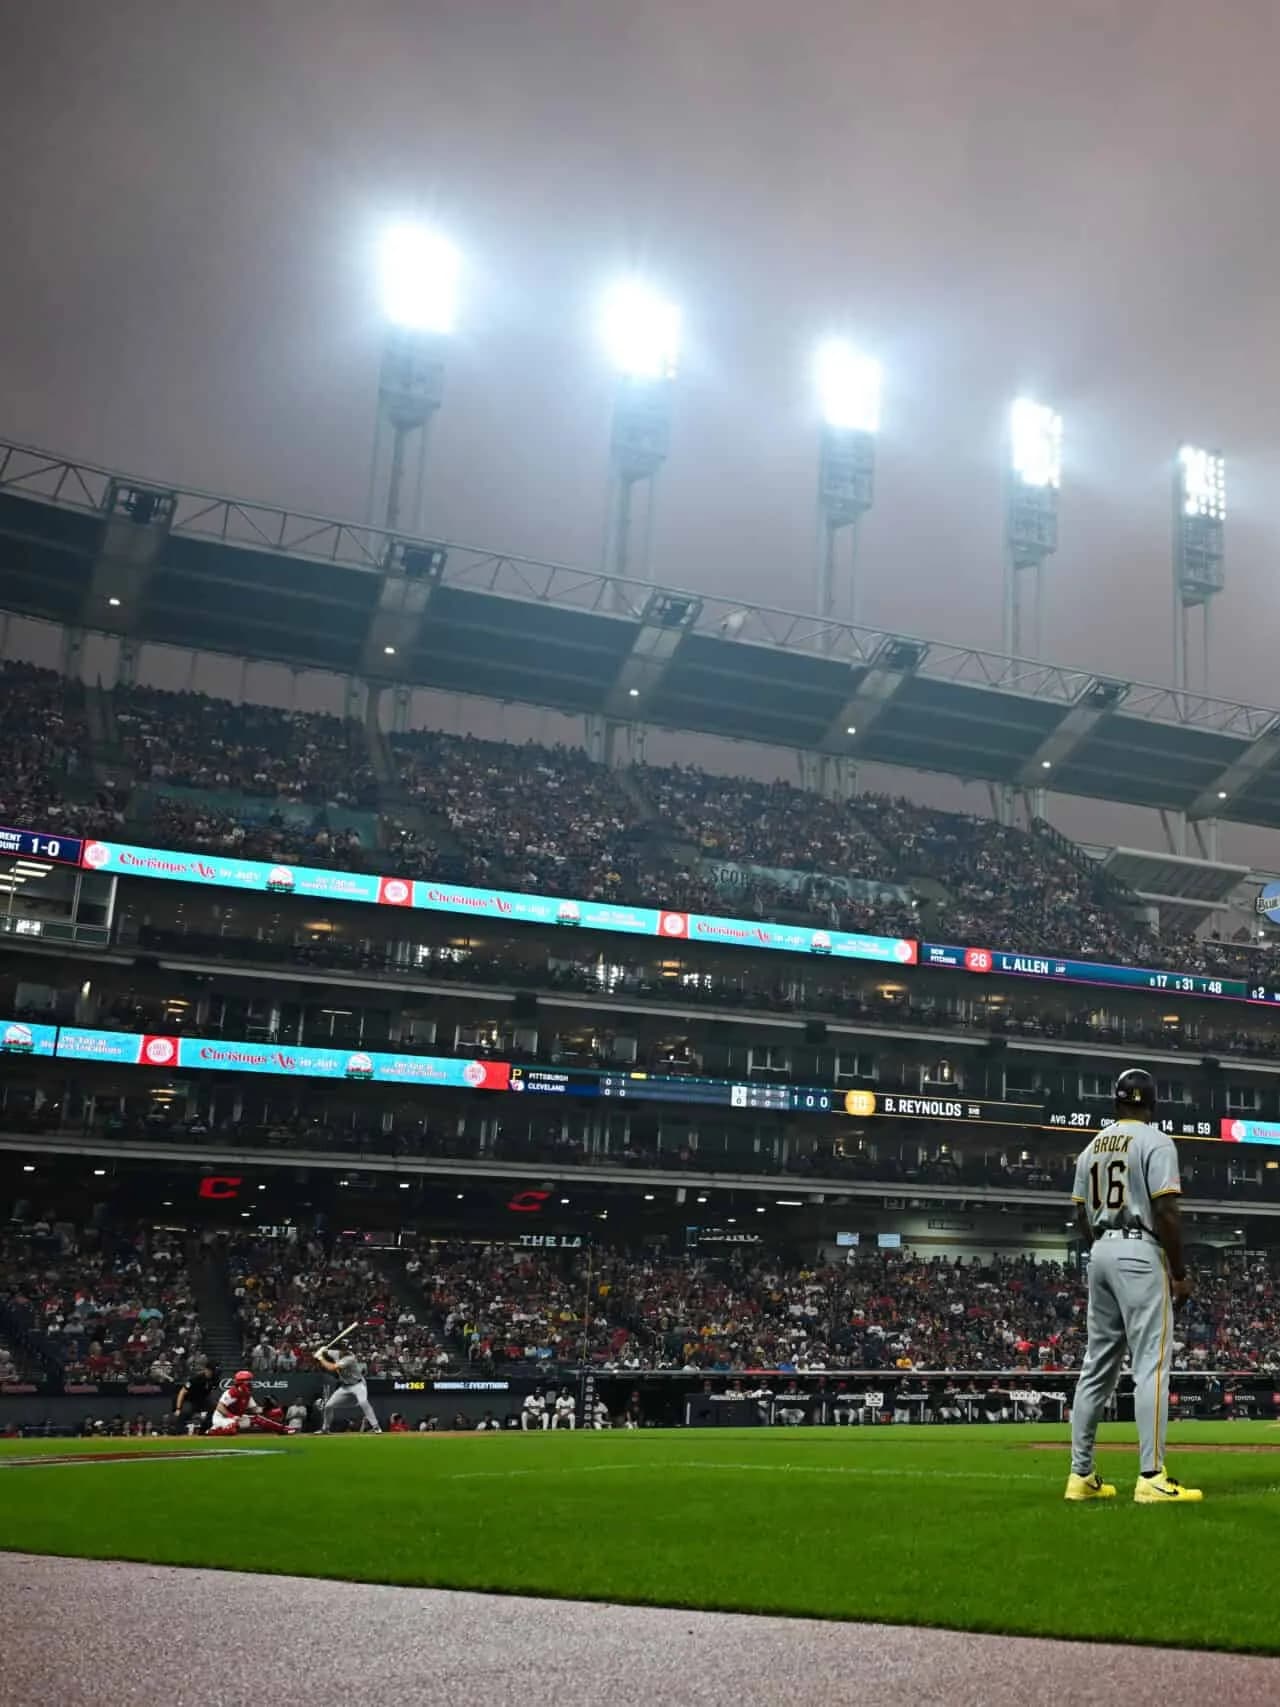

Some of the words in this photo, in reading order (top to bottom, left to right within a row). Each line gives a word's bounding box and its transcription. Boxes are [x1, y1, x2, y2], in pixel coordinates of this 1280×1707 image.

[31, 838, 60, 857] 1-0
[118, 852, 188, 874] Christmas
[427, 888, 488, 908] Christmas
[696, 921, 750, 938] Christmas
[930, 955, 957, 965] PITCHING
[970, 952, 987, 968] 26
[1002, 957, 1013, 970] L.
[1014, 958, 1049, 974] ALLEN
[1156, 975, 1168, 988] 17
[1182, 977, 1194, 991] 31
[1208, 981, 1222, 994] 48
[1258, 987, 1265, 999] 2
[200, 1047, 267, 1065] Christmas
[527, 1082, 566, 1092] CLEVELAND
[604, 1088, 611, 1096] 0
[619, 1089, 626, 1097] 0
[528, 1072, 569, 1082] PITTSBURGH
[605, 1078, 612, 1086] 0
[806, 1095, 814, 1107] 0
[820, 1096, 828, 1108] 0
[885, 1097, 896, 1112] B.
[898, 1099, 962, 1117] REYNOLDS
[1050, 1114, 1066, 1125] AVG
[1067, 1112, 1091, 1128] .287
[1161, 1119, 1174, 1132] 14
[1196, 1121, 1211, 1135] 59
[1093, 1134, 1134, 1155] BROCK
[200, 1176, 242, 1199] C
[1090, 1159, 1127, 1210] 16
[508, 1190, 551, 1212] C
[519, 1235, 557, 1247] THE
[250, 1380, 289, 1389] EXUS
[394, 1380, 425, 1390] bet365
